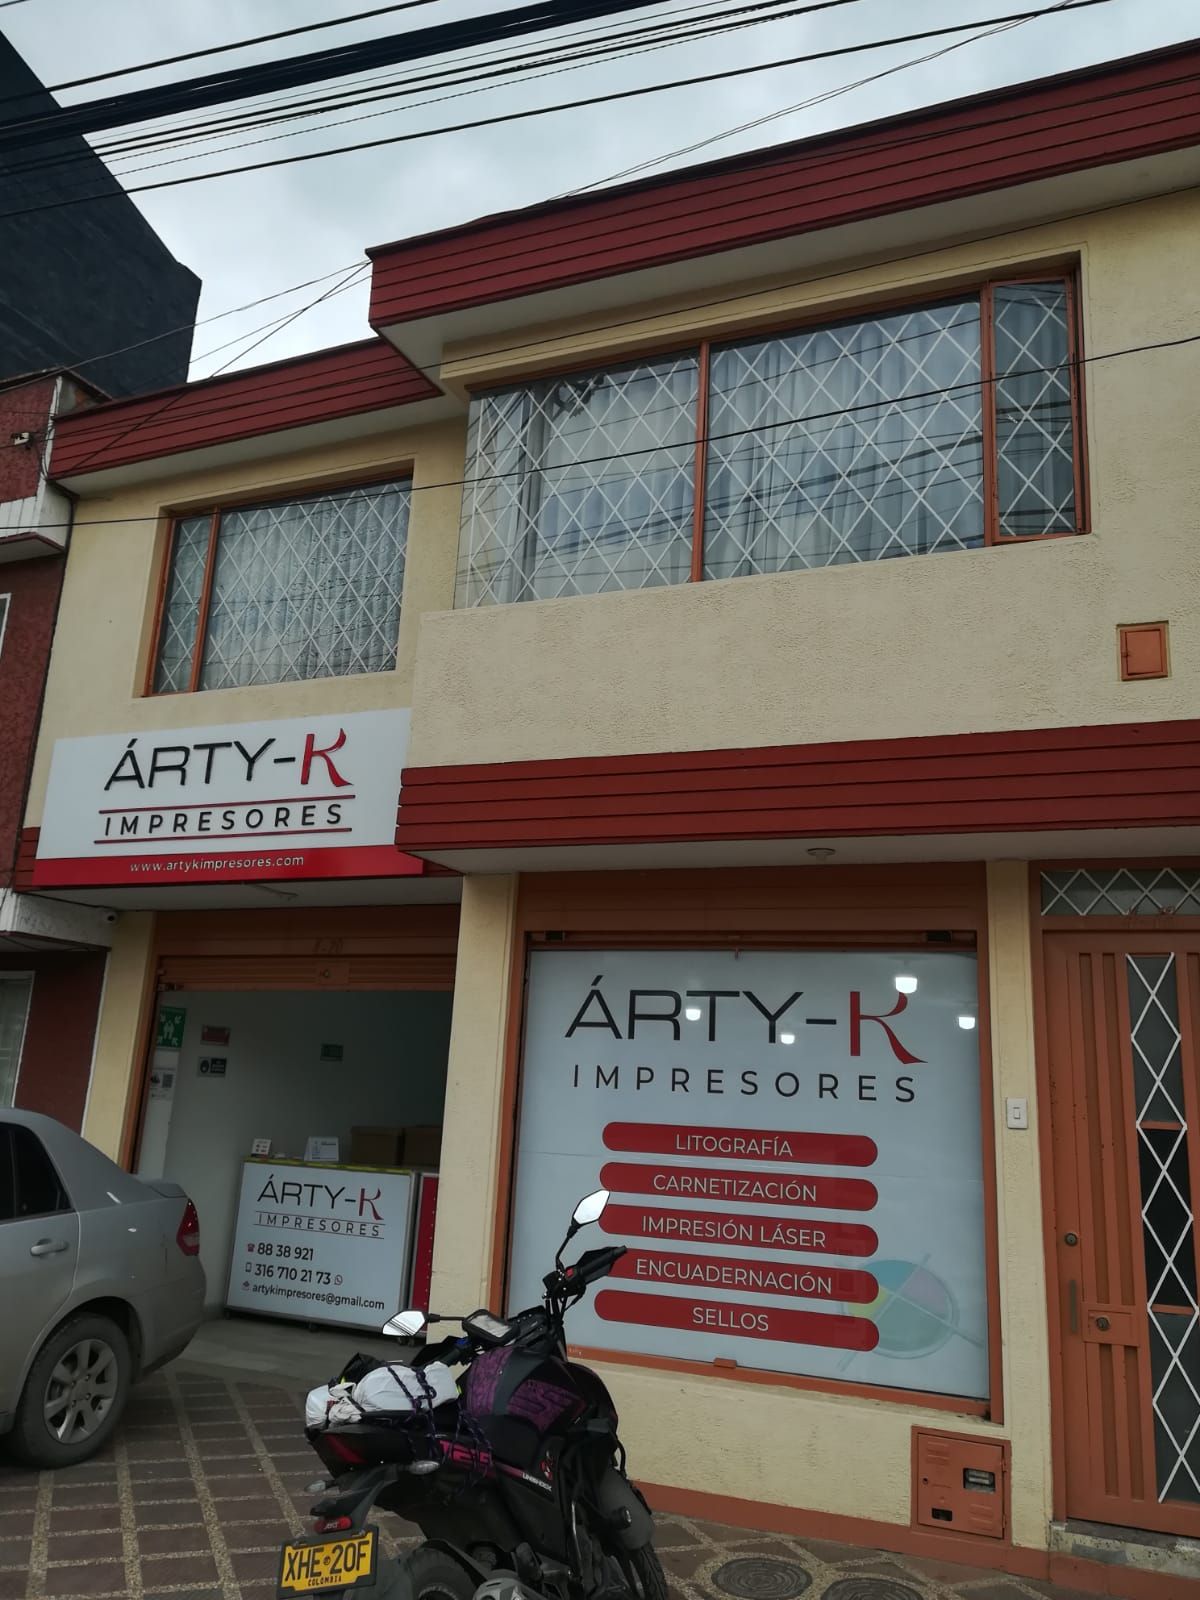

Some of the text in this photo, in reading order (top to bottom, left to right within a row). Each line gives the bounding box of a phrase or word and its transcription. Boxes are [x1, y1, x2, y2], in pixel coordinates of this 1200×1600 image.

[104, 728, 353, 791] ÁRTY-K
[104, 804, 342, 836] IMPRESORES
[129, 855, 304, 873] www.artykimpresores.com
[564, 975, 929, 1064] ÁRTY-K
[573, 1064, 915, 1102] IMPRESORES
[675, 1134, 793, 1157] LITOGRAFÍA
[257, 1174, 384, 1220] ÁRTY-K
[653, 1173, 817, 1202] CARNETIZACIÓN
[258, 1213, 380, 1236] IMPRESORES
[642, 1215, 826, 1247] IMPRESIÓN LÁSER
[257, 1242, 314, 1261] 88 38 921
[254, 1263, 331, 1285] 316 710 21 73
[636, 1258, 832, 1294] ENCUADERNACIÓN
[252, 1283, 385, 1310] artykimpresores@gmail.com
[692, 1307, 769, 1332] SELLOS
[285, 1540, 370, 1581] XHE 20F
[308, 1576, 342, 1586] COLOMBIA
